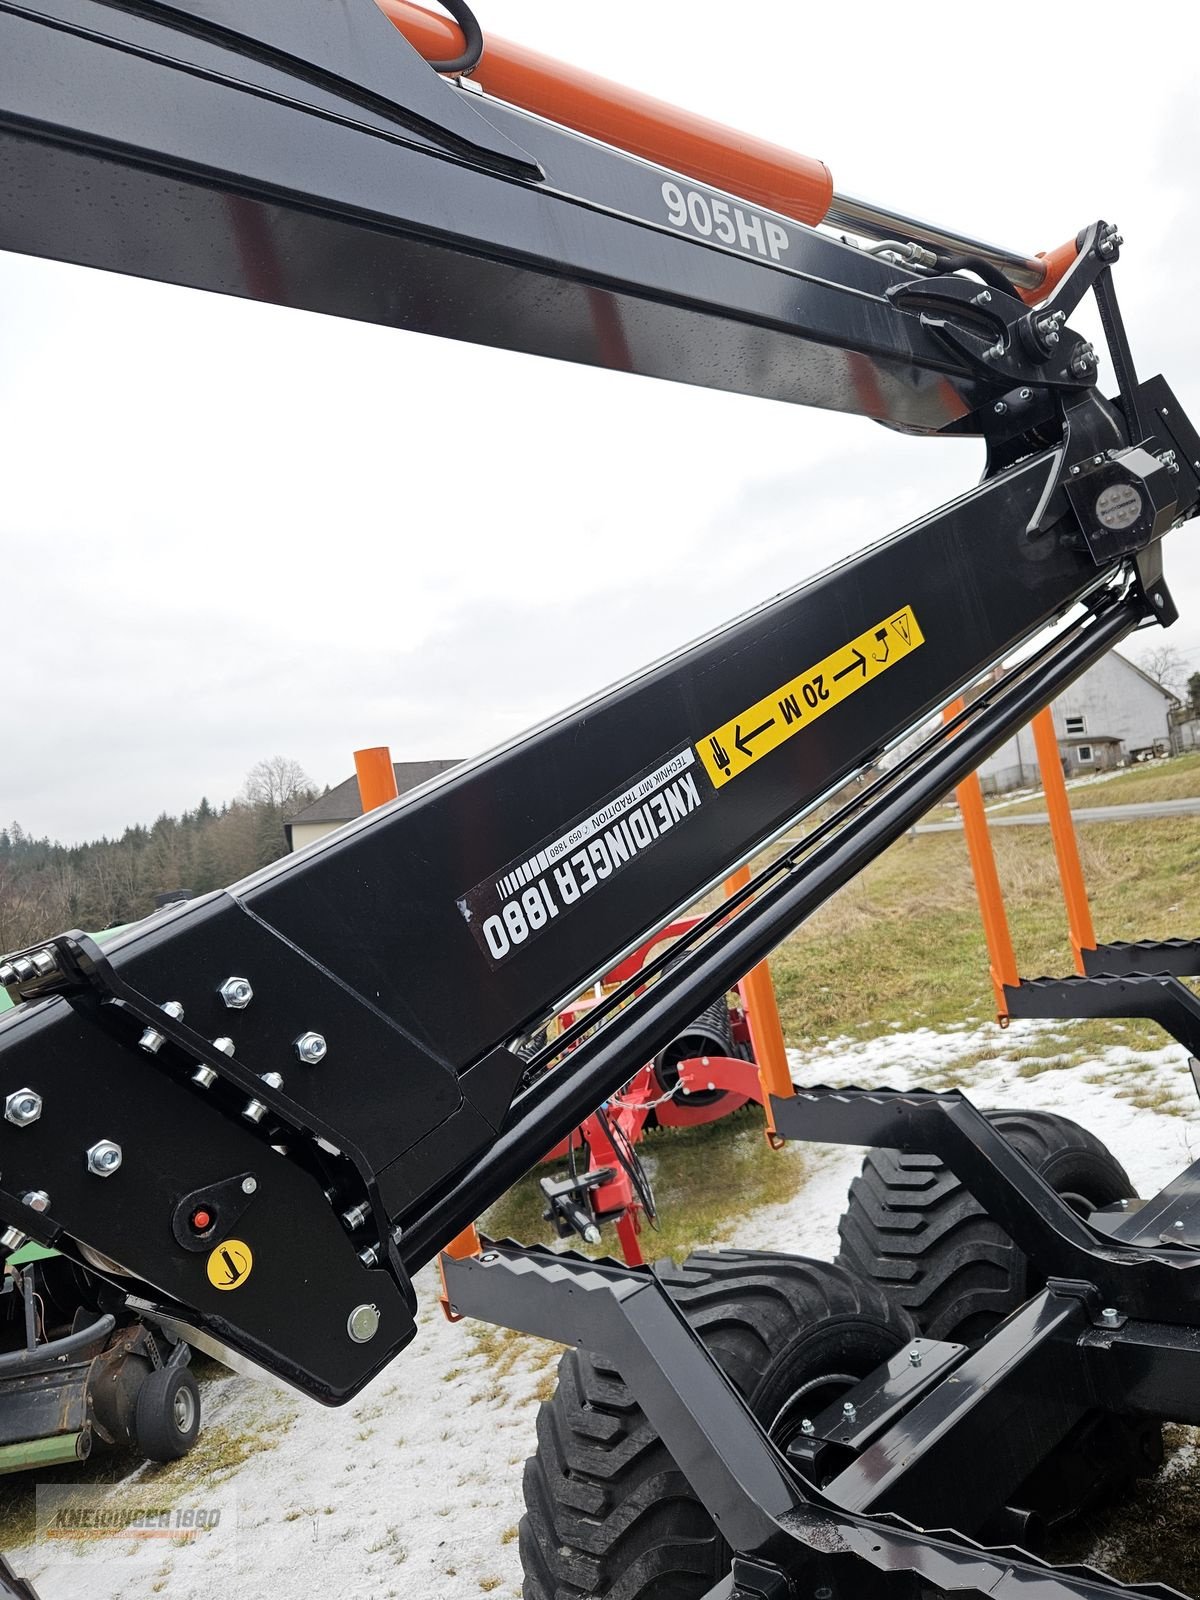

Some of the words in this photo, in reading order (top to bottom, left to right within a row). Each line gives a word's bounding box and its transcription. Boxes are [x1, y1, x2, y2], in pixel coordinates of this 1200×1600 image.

[661, 181, 789, 260] 905HP
[802, 674, 830, 708] 20
[778, 693, 803, 725] M
[654, 755, 687, 785] TECHNIK
[639, 779, 654, 797] MIT
[591, 791, 638, 830] TRADITION
[549, 842, 568, 858] 1880
[553, 772, 702, 905] KNEIDINGER
[568, 829, 583, 845] 059
[482, 878, 559, 960] 1880
